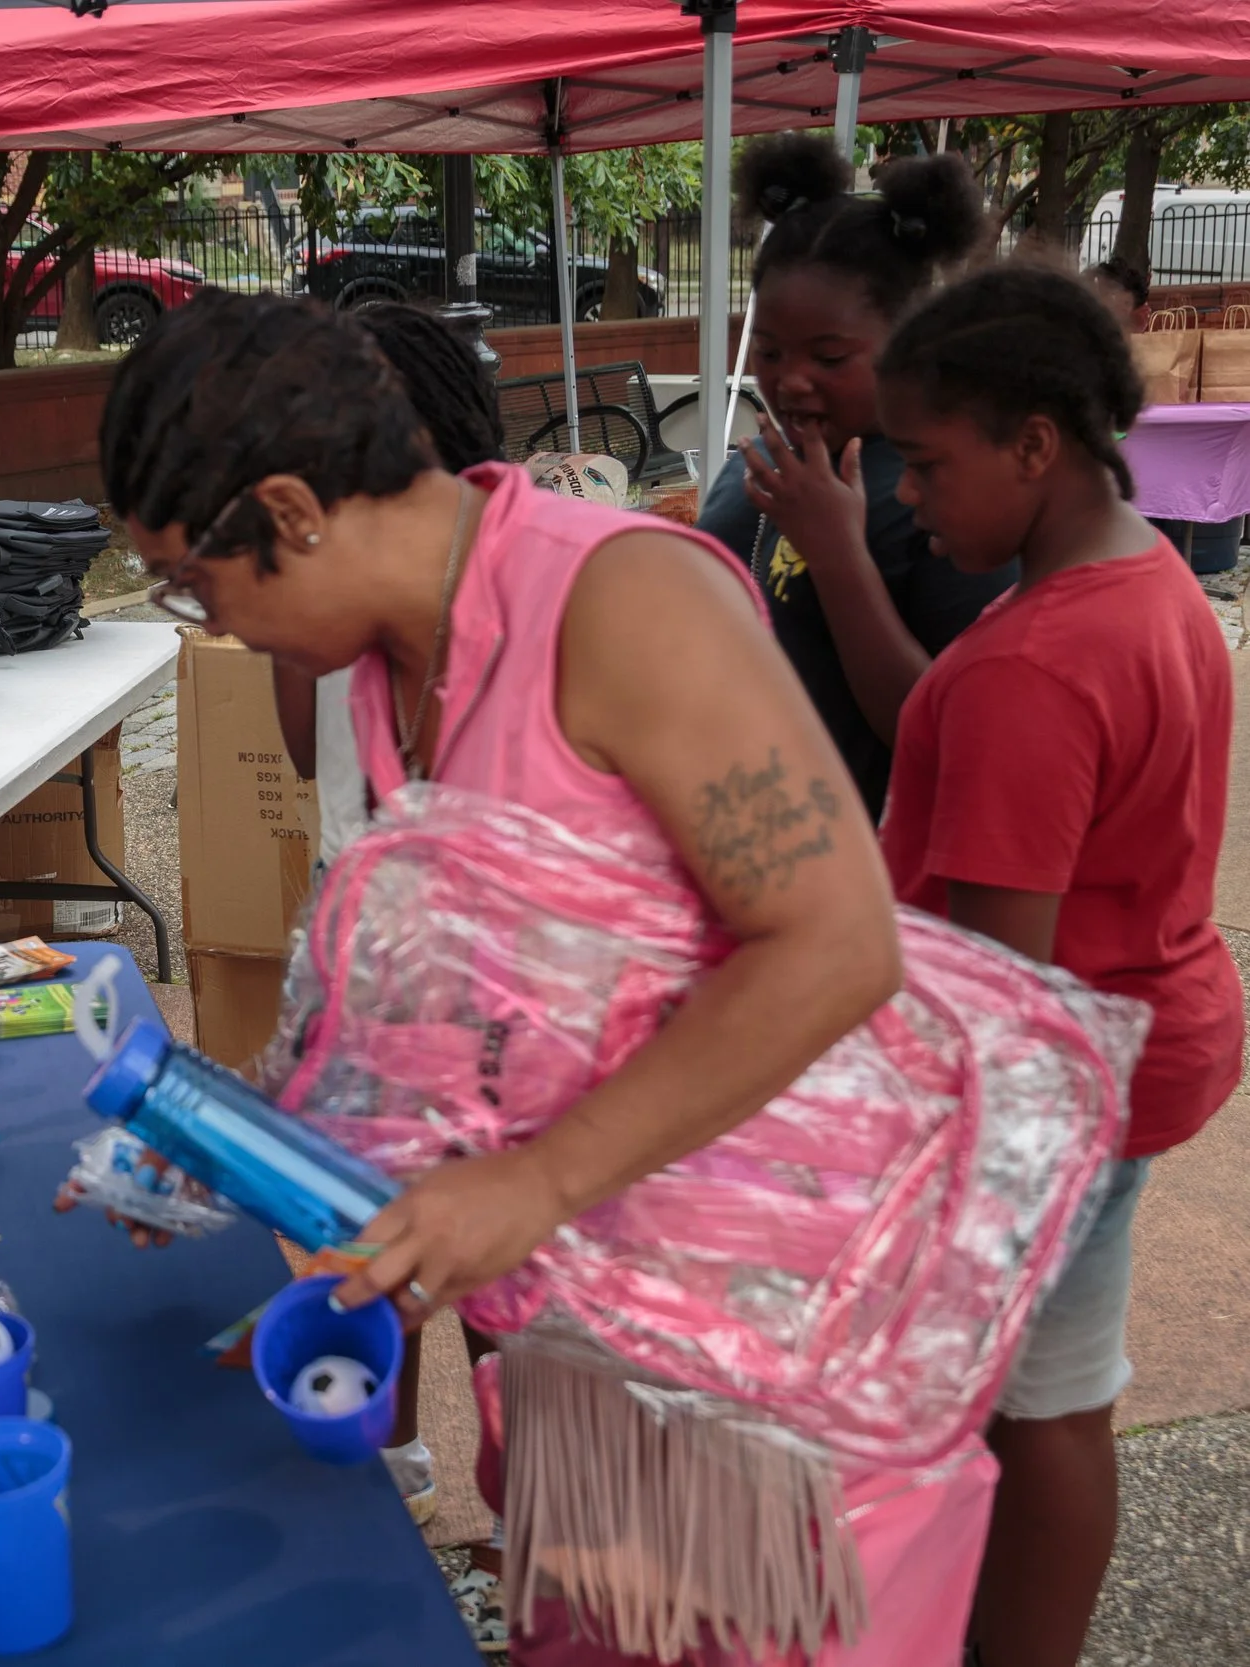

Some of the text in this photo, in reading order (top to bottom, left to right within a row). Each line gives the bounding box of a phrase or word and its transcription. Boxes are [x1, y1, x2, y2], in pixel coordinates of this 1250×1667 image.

[238, 752, 255, 763] CM
[256, 771, 281, 783] KGS
[258, 790, 283, 801] KGS
[1, 811, 83, 824] AUTHORITY
[260, 809, 283, 820] PCS
